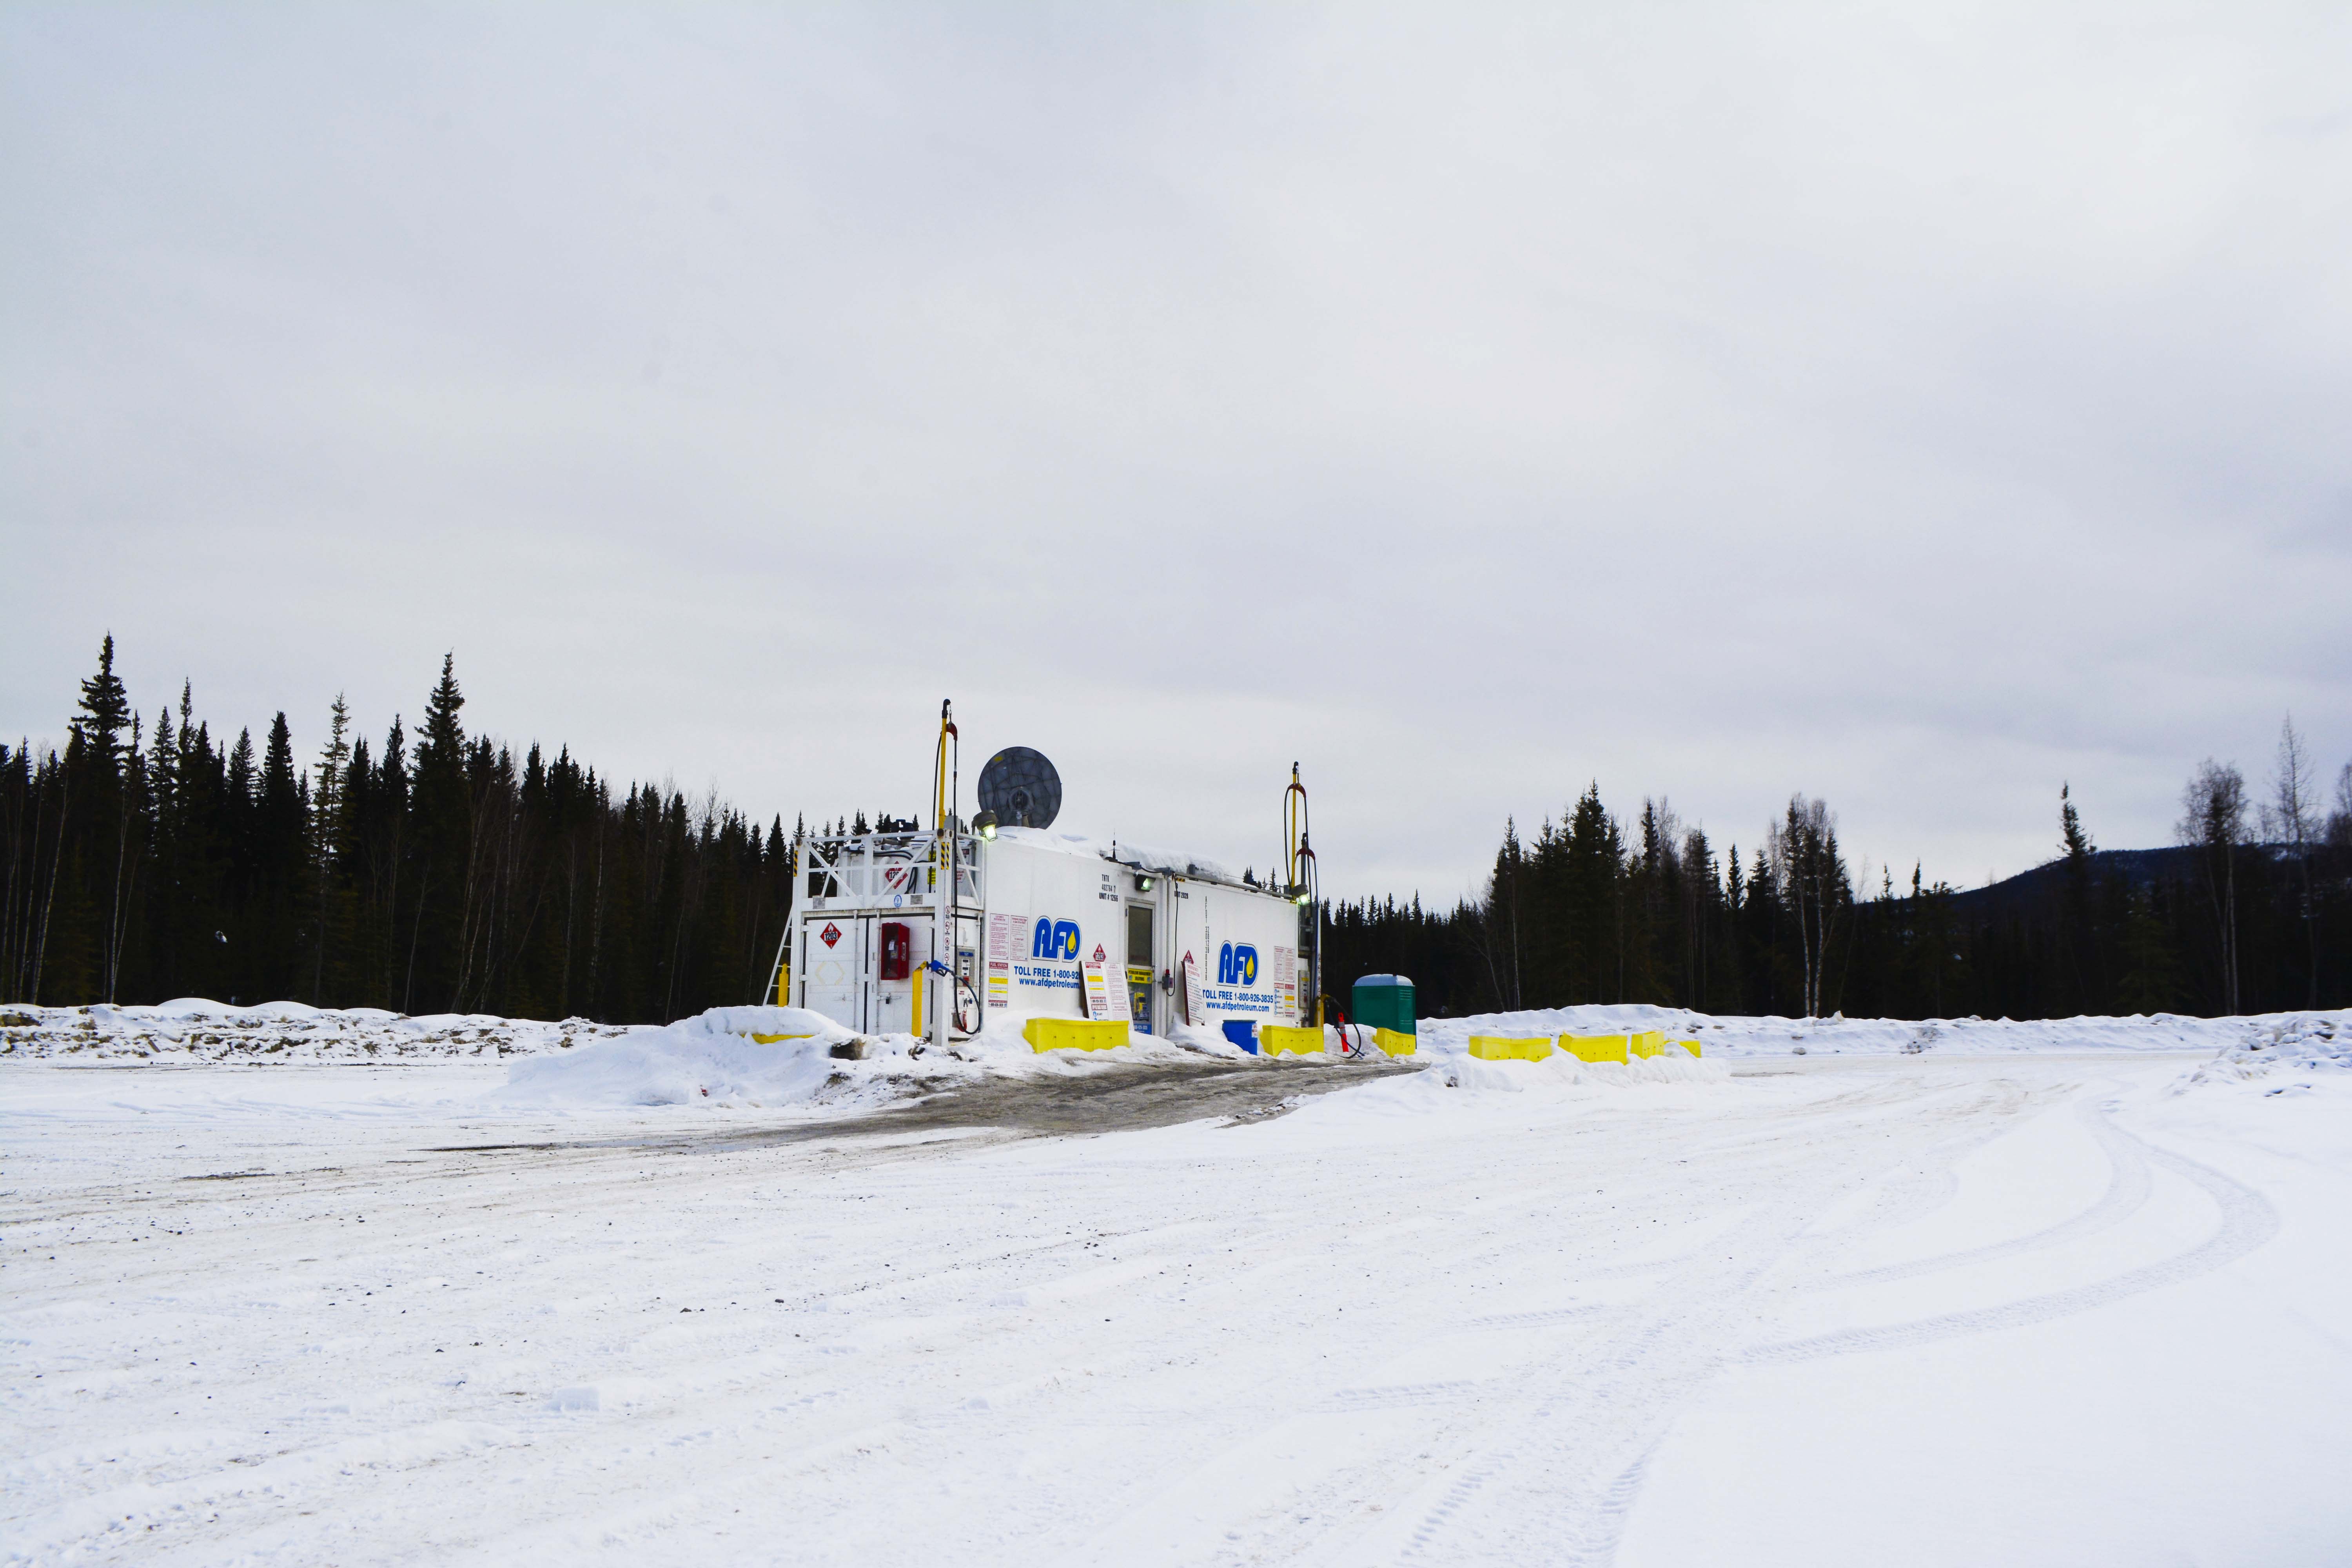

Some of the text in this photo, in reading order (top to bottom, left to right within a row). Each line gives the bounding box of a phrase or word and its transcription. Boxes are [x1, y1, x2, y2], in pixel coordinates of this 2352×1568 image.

[825, 932, 837, 940] 1203
[1032, 916, 1081, 962] AFD
[1217, 941, 1258, 987] AFD
[1014, 966, 1080, 980] TOLL FREE 1-800-92
[1203, 990, 1274, 1003] TOLL FREE 1-800-926-3835
[1206, 1001, 1270, 1012] www.afdpetroleum.com
